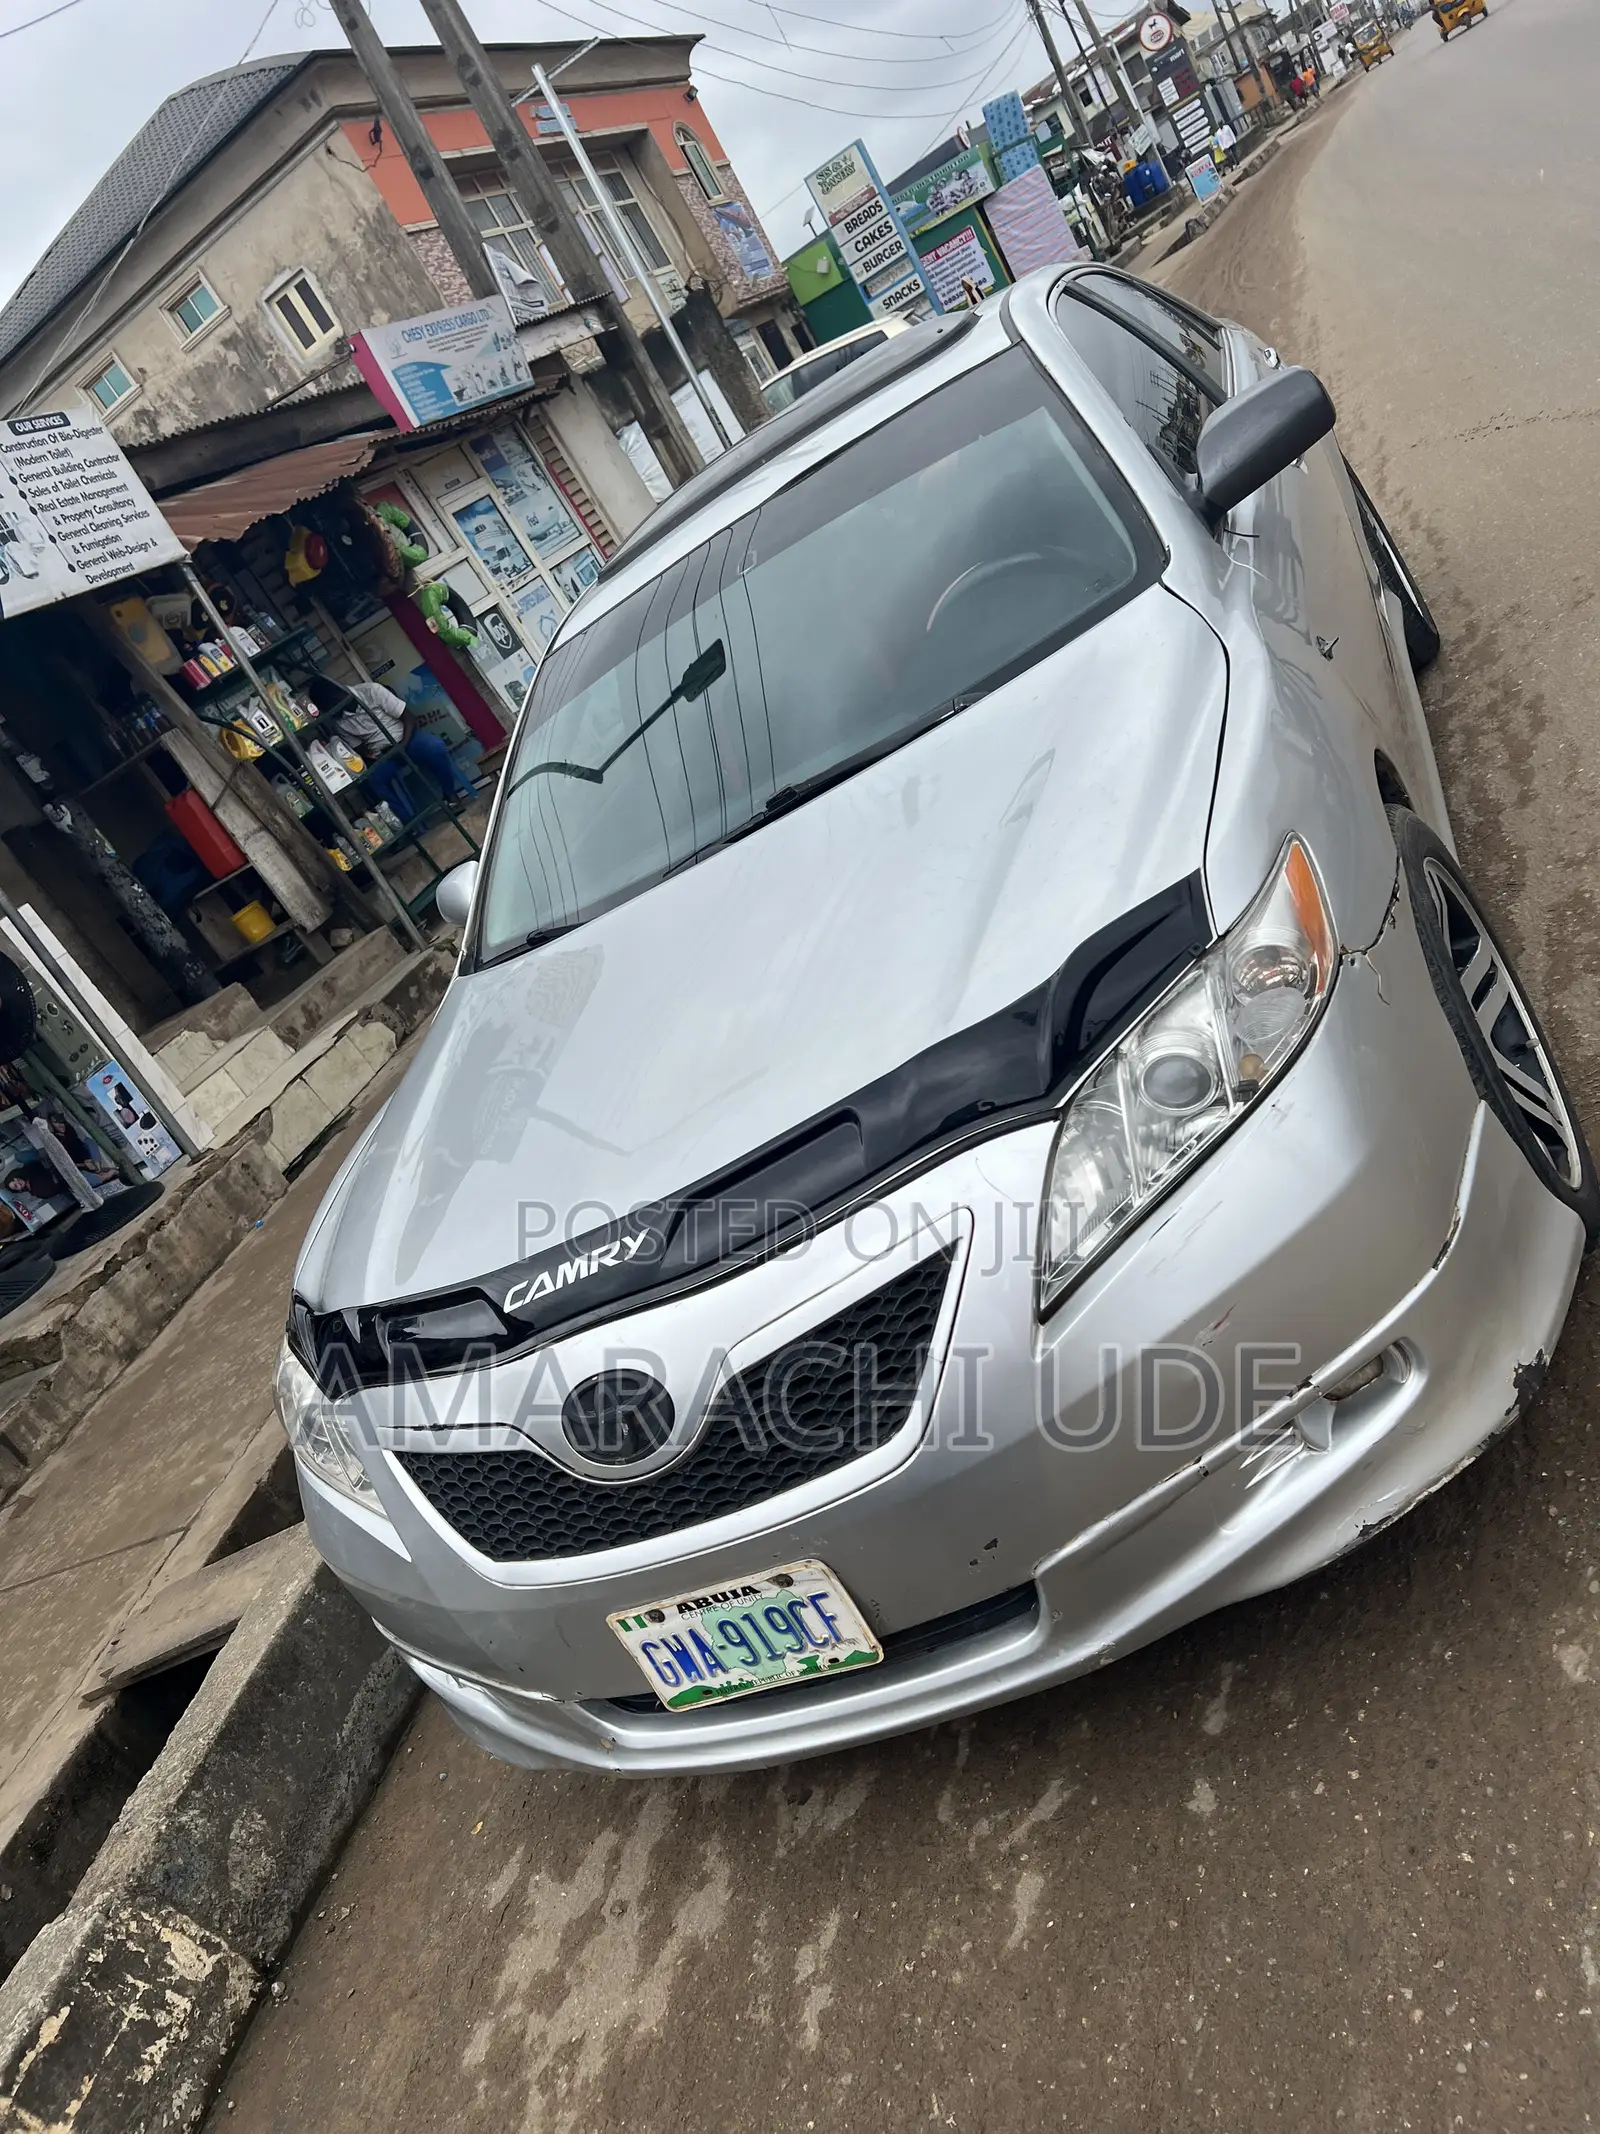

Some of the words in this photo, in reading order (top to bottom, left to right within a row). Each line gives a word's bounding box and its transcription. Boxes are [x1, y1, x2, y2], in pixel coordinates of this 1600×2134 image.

[844, 200, 883, 234] BREADS
[854, 220, 893, 253] CAKES
[862, 240, 904, 273] BURGER
[882, 279, 920, 310] SNACKS
[0, 437, 49, 453] Construction
[61, 425, 104, 442] Bio-Digester
[15, 420, 34, 433] OUR
[33, 415, 65, 430] SERVICES
[13, 451, 50, 469] (Modern
[49, 447, 74, 462] Toilet)
[19, 468, 52, 483] General
[52, 461, 86, 477] Building
[83, 453, 121, 469] Contractor
[27, 485, 52, 499] Sales
[51, 481, 61, 493] of
[60, 477, 82, 491] Toilet
[82, 469, 118, 486] Chemicals
[37, 498, 59, 514] Real
[58, 493, 82, 508] Estate
[82, 483, 130, 503] Management
[52, 515, 62, 526] &
[61, 510, 94, 527] Property
[93, 497, 136, 515] Consultancy
[57, 528, 90, 542] General
[89, 517, 123, 534] Cleaning
[122, 510, 151, 525] Services
[71, 544, 81, 555] &
[80, 534, 123, 553] Fumigation
[76, 556, 109, 570] General
[108, 542, 151, 562] Web-Design
[149, 537, 159, 549] &
[85, 562, 135, 585] Development
[503, 1227, 651, 1314] CAMRY
[676, 1586, 761, 1614] ABUJA
[681, 1604, 721, 1621] CENTRE
[721, 1600, 735, 1610] OF
[736, 1592, 766, 1605] UNITY
[641, 1591, 844, 1688] GWA-919CF
[749, 1671, 787, 1687] REPUBLIC
